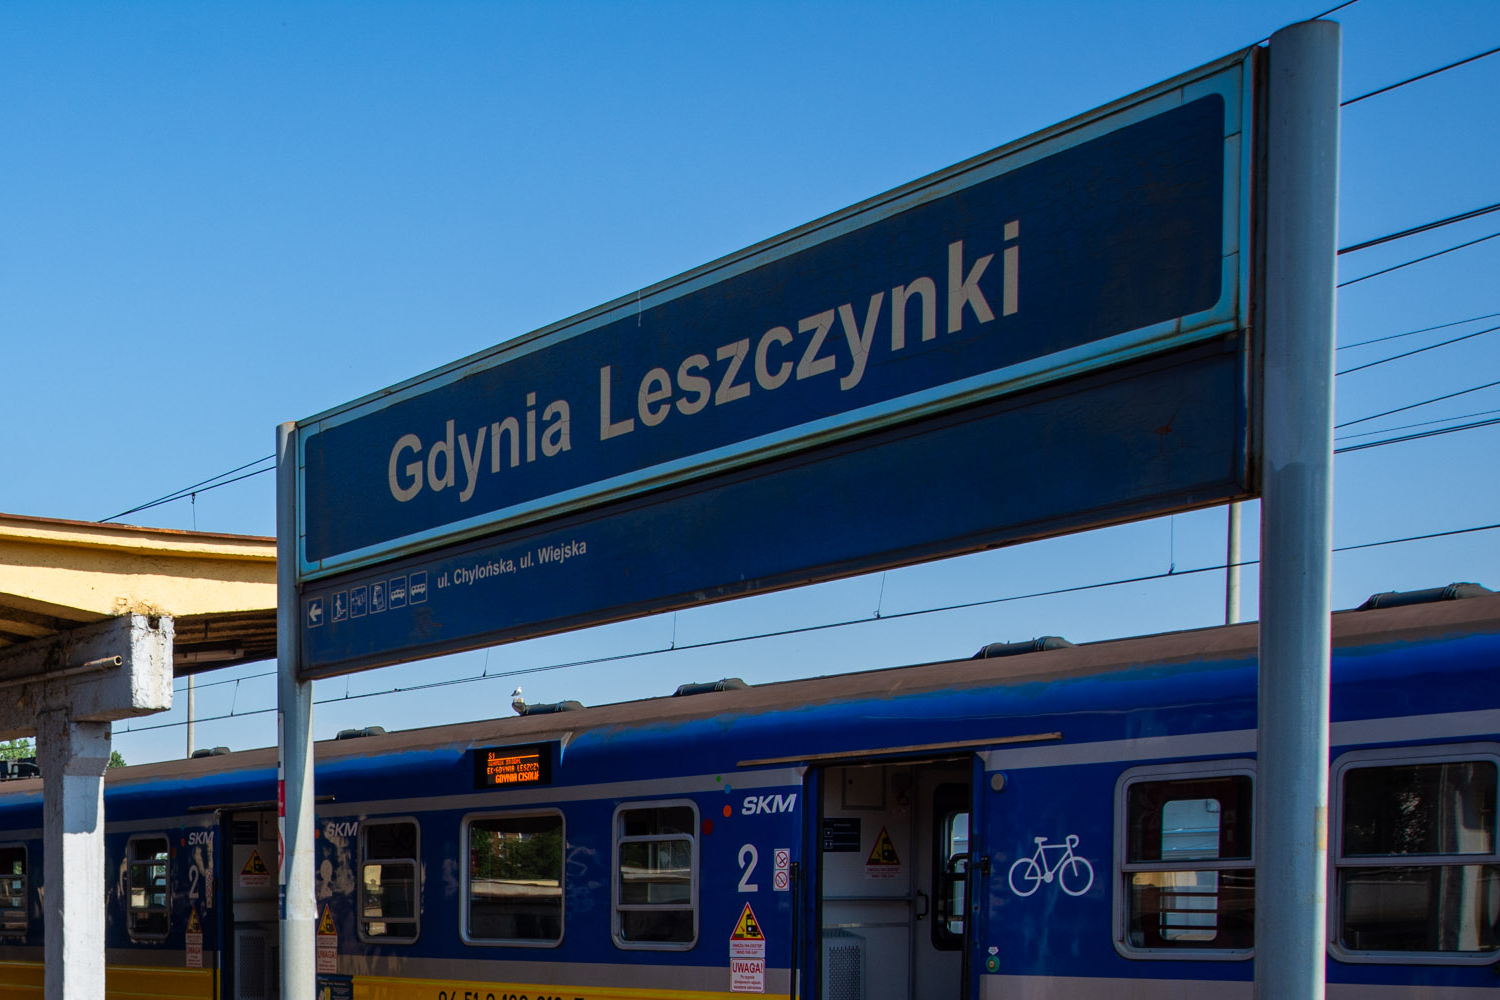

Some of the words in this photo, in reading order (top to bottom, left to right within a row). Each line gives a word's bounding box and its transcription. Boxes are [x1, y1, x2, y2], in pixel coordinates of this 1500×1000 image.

[388, 392, 573, 503] Gdynia
[600, 219, 1020, 441] Leszczynki
[437, 571, 451, 589] ul.
[453, 558, 517, 586] Chylońska,
[520, 551, 534, 569] ul.
[537, 540, 587, 564] Wiejska
[495, 773, 518, 784] GDYNIA
[741, 793, 798, 816] SKM
[188, 831, 215, 846] SKM
[326, 821, 359, 838] SKM
[737, 843, 759, 893] 2
[189, 865, 200, 899] 2
[732, 962, 763, 974] UWAGA!
